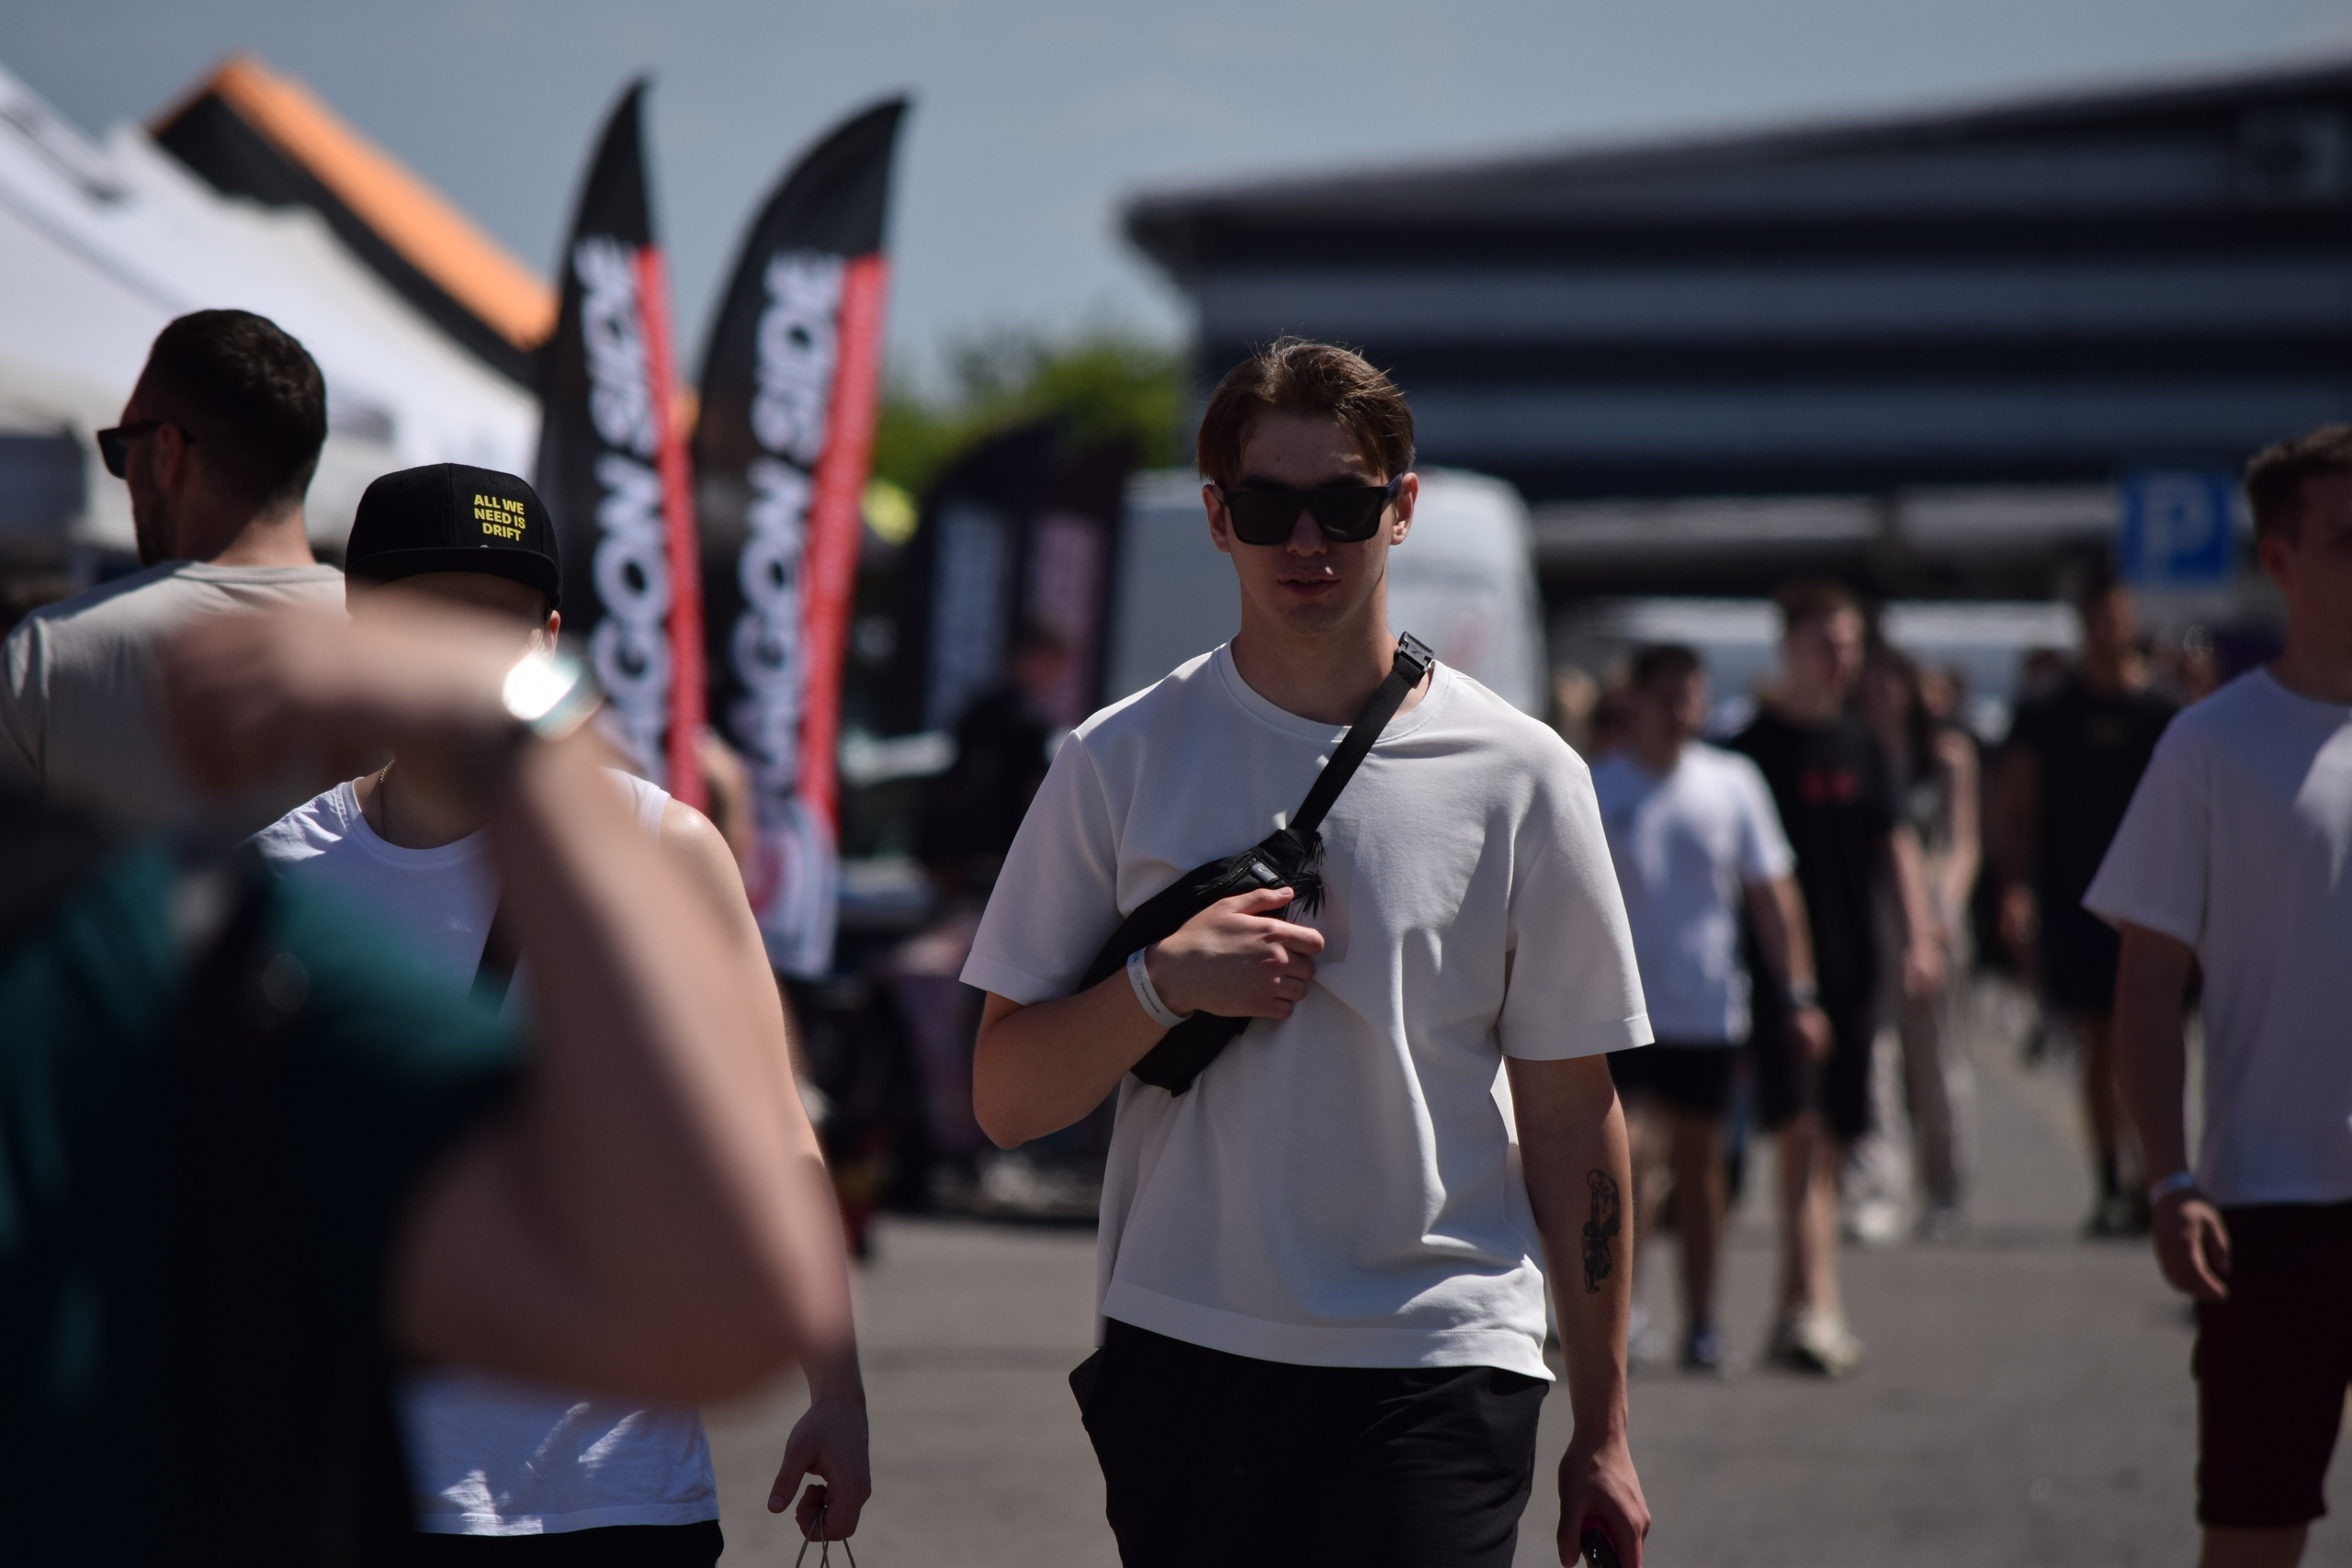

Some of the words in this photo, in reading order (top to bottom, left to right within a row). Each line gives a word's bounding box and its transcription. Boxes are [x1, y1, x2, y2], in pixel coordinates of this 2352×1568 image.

[571, 235, 658, 457] SIDE
[752, 249, 846, 468] SIDE
[474, 494, 501, 509] ALL
[502, 499, 525, 514] WE
[474, 508, 512, 525] NEED
[514, 515, 526, 529] IS
[481, 523, 521, 541] DRIFT
[2144, 476, 2213, 575] P
[589, 451, 673, 792] AGON
[1140, 982, 1160, 1013] ТИНЬКОФФ
